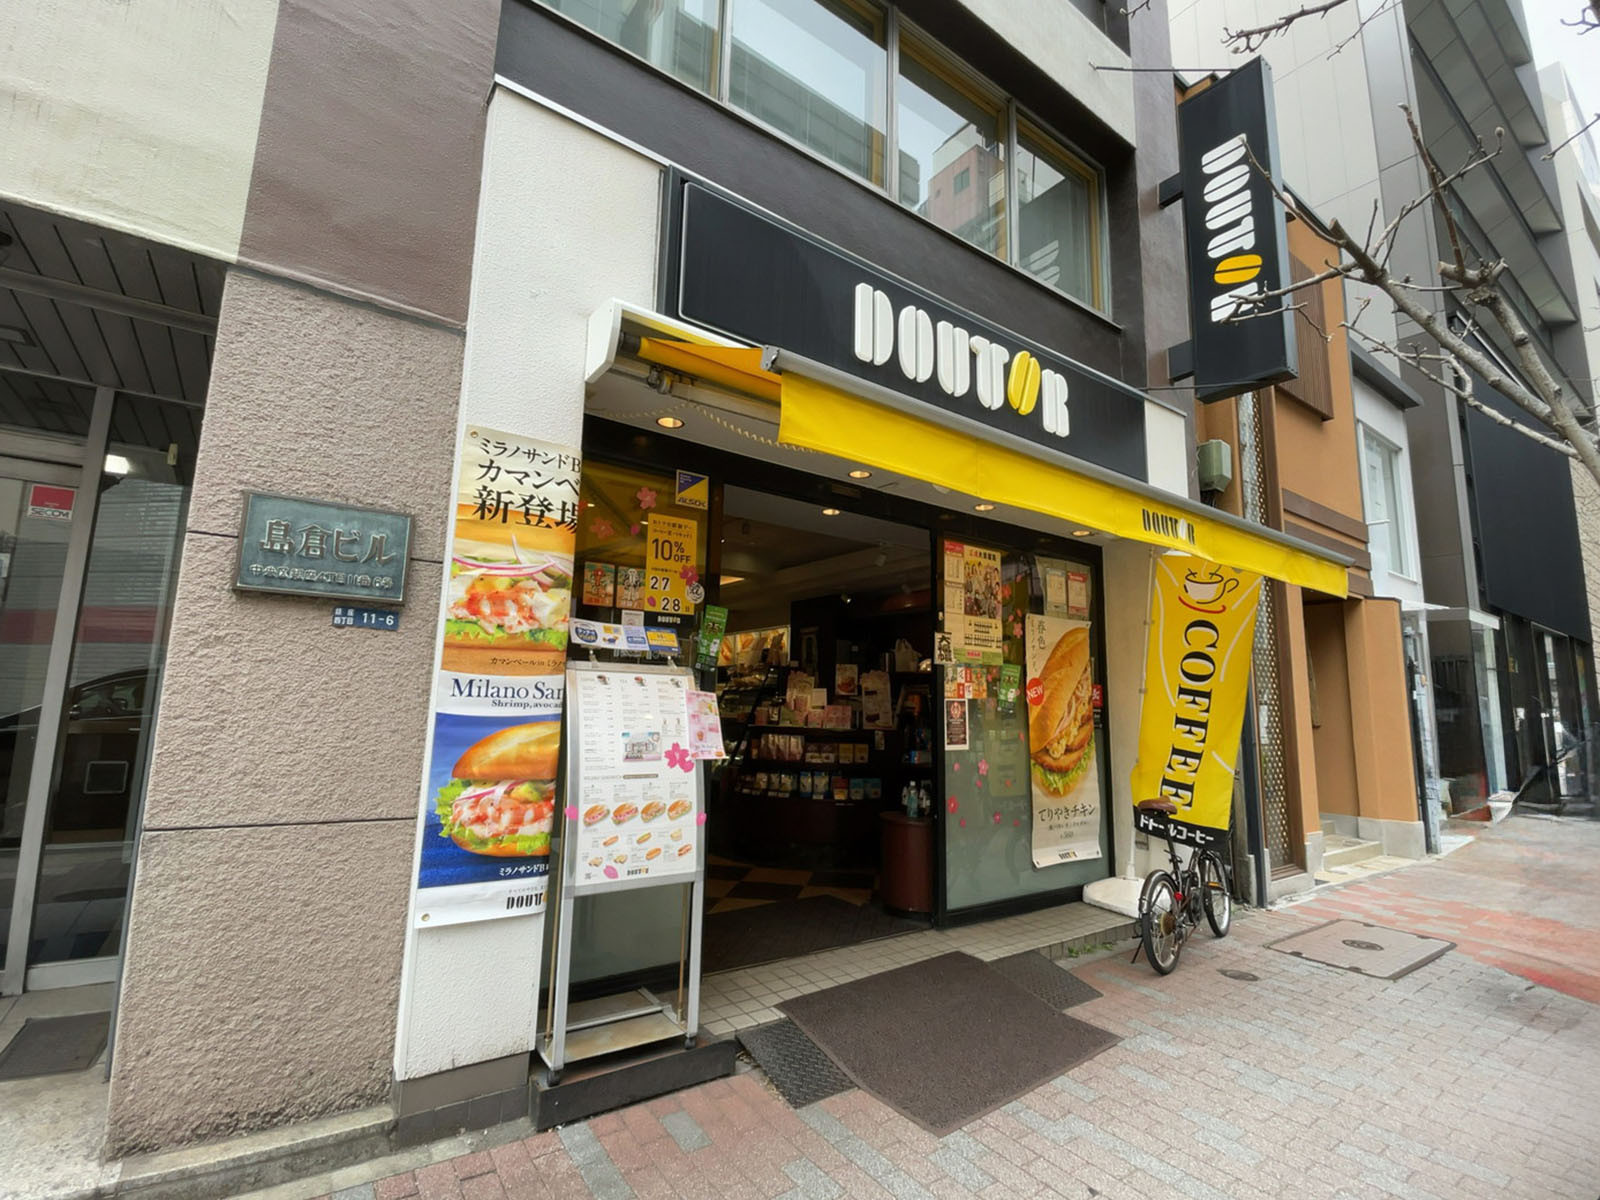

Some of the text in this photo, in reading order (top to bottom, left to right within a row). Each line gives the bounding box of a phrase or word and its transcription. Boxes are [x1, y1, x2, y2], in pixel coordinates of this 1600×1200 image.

[1201, 133, 1262, 322] DOUTOR
[855, 282, 1070, 437] DOUTOR
[480, 437, 581, 473] ミラノサンドB
[31, 507, 70, 518] SECOM
[1142, 508, 1195, 545] DOUTOR
[259, 518, 396, 564] 島倉ビル
[673, 554, 691, 564] OFF
[650, 576, 670, 591] 27
[661, 597, 680, 612] 28
[362, 613, 394, 626] 11-6
[450, 678, 529, 699] Milano
[1028, 685, 1044, 700] NEW
[1159, 619, 1220, 810] COFFEE
[1038, 803, 1096, 822] てりやきチキン
